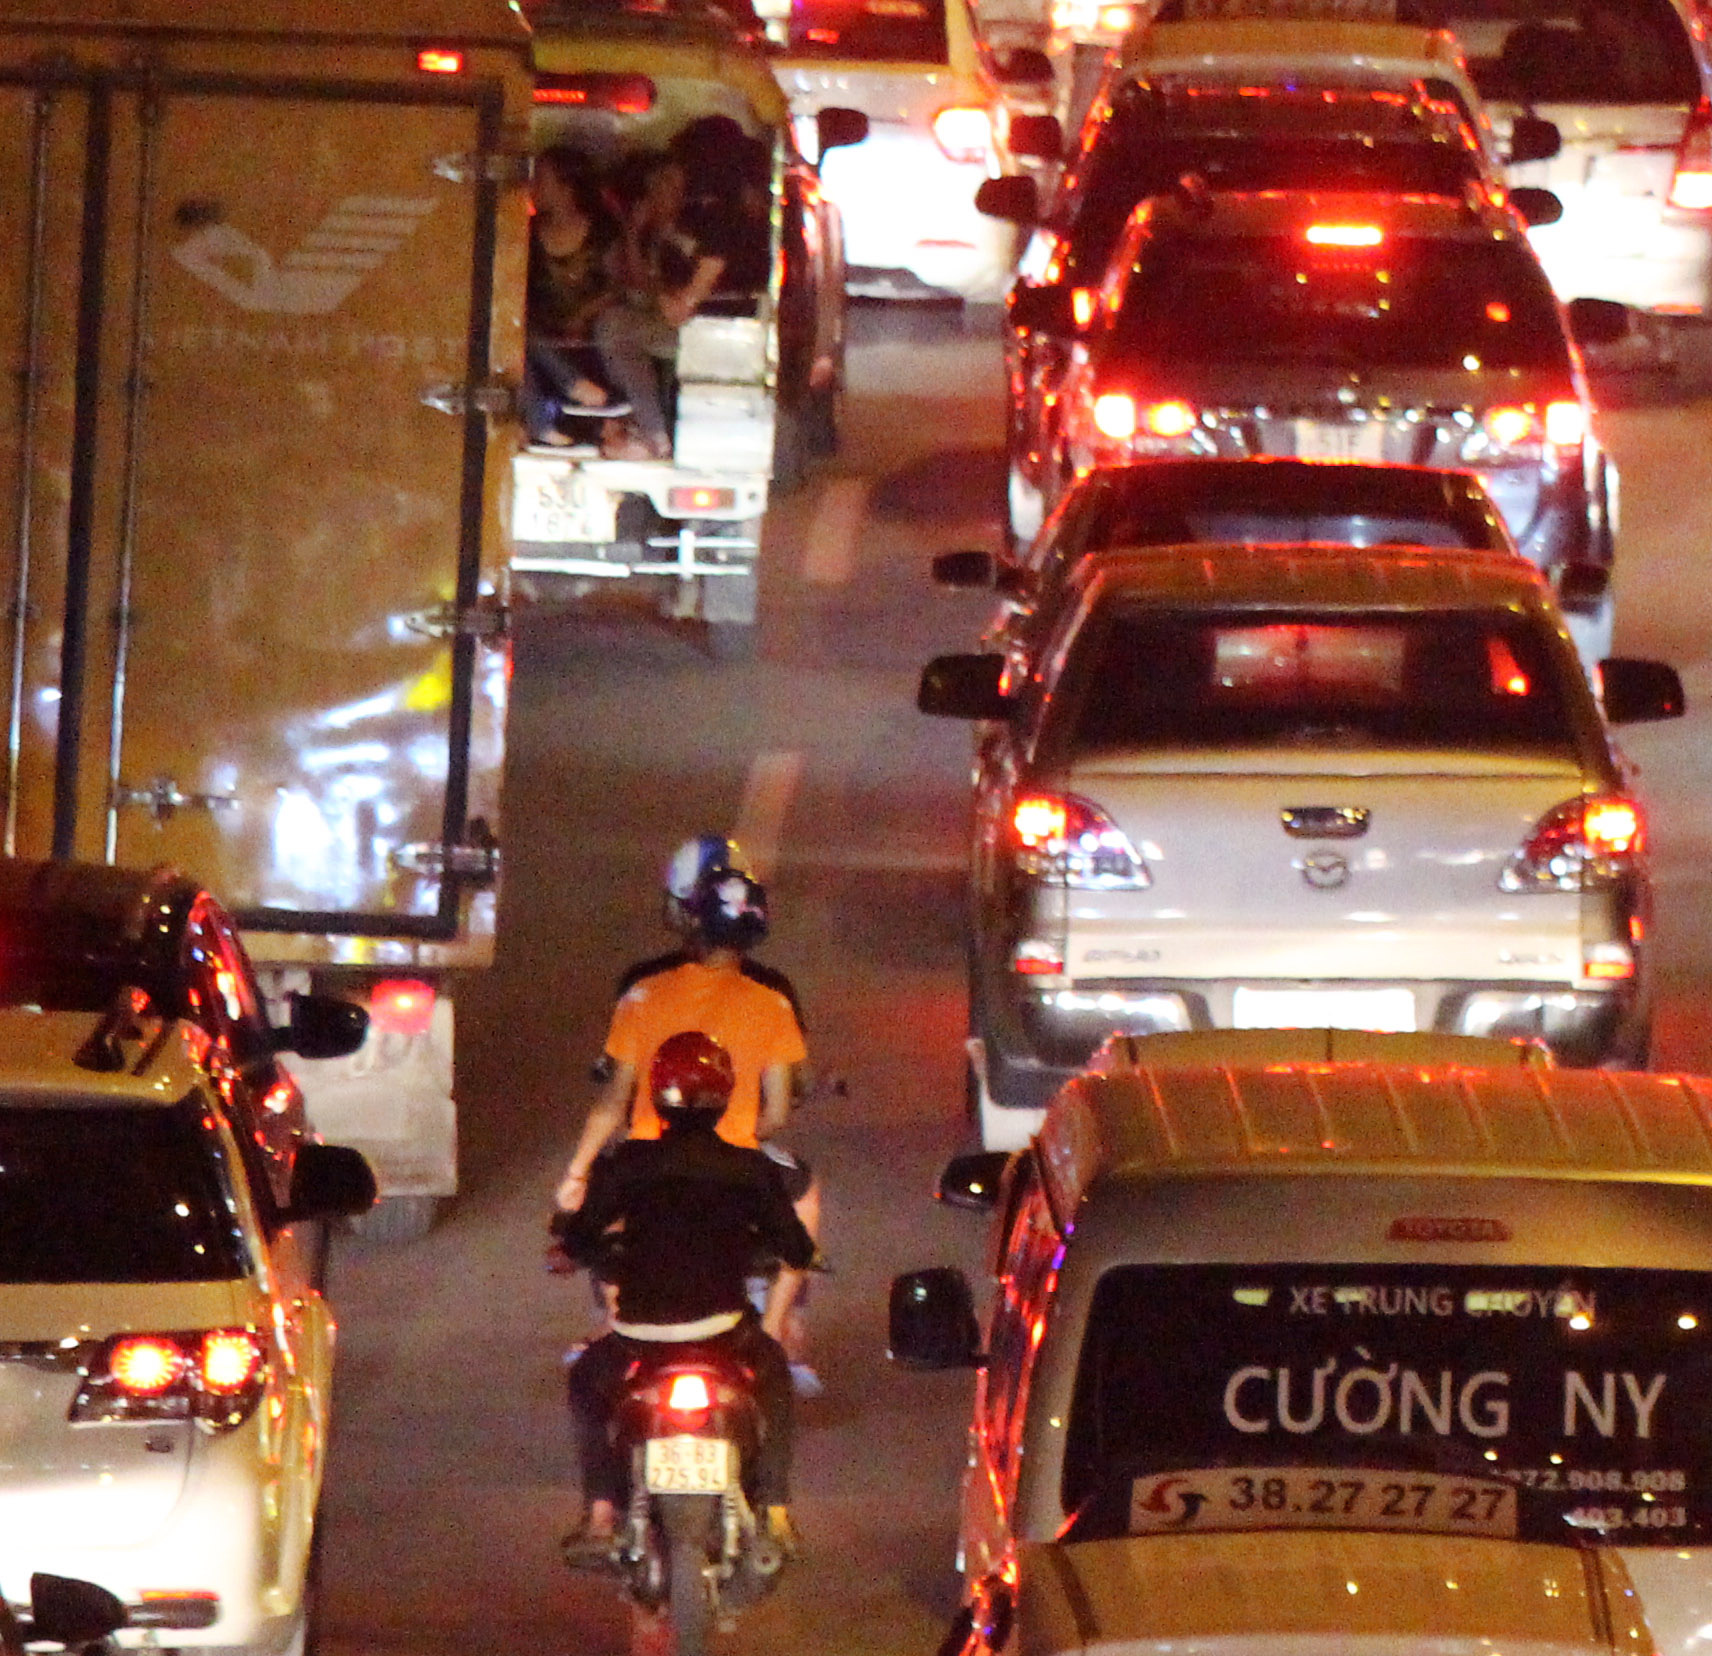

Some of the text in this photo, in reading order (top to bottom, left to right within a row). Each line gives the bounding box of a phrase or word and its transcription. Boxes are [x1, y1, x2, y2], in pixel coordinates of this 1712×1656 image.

[1289, 1285, 1328, 1315] XE
[1334, 1285, 1453, 1317] TRUNG
[1223, 1344, 1667, 1440] CƯỜNG NY
[1379, 1482, 1430, 1520] 27
[1447, 1485, 1503, 1523] 27
